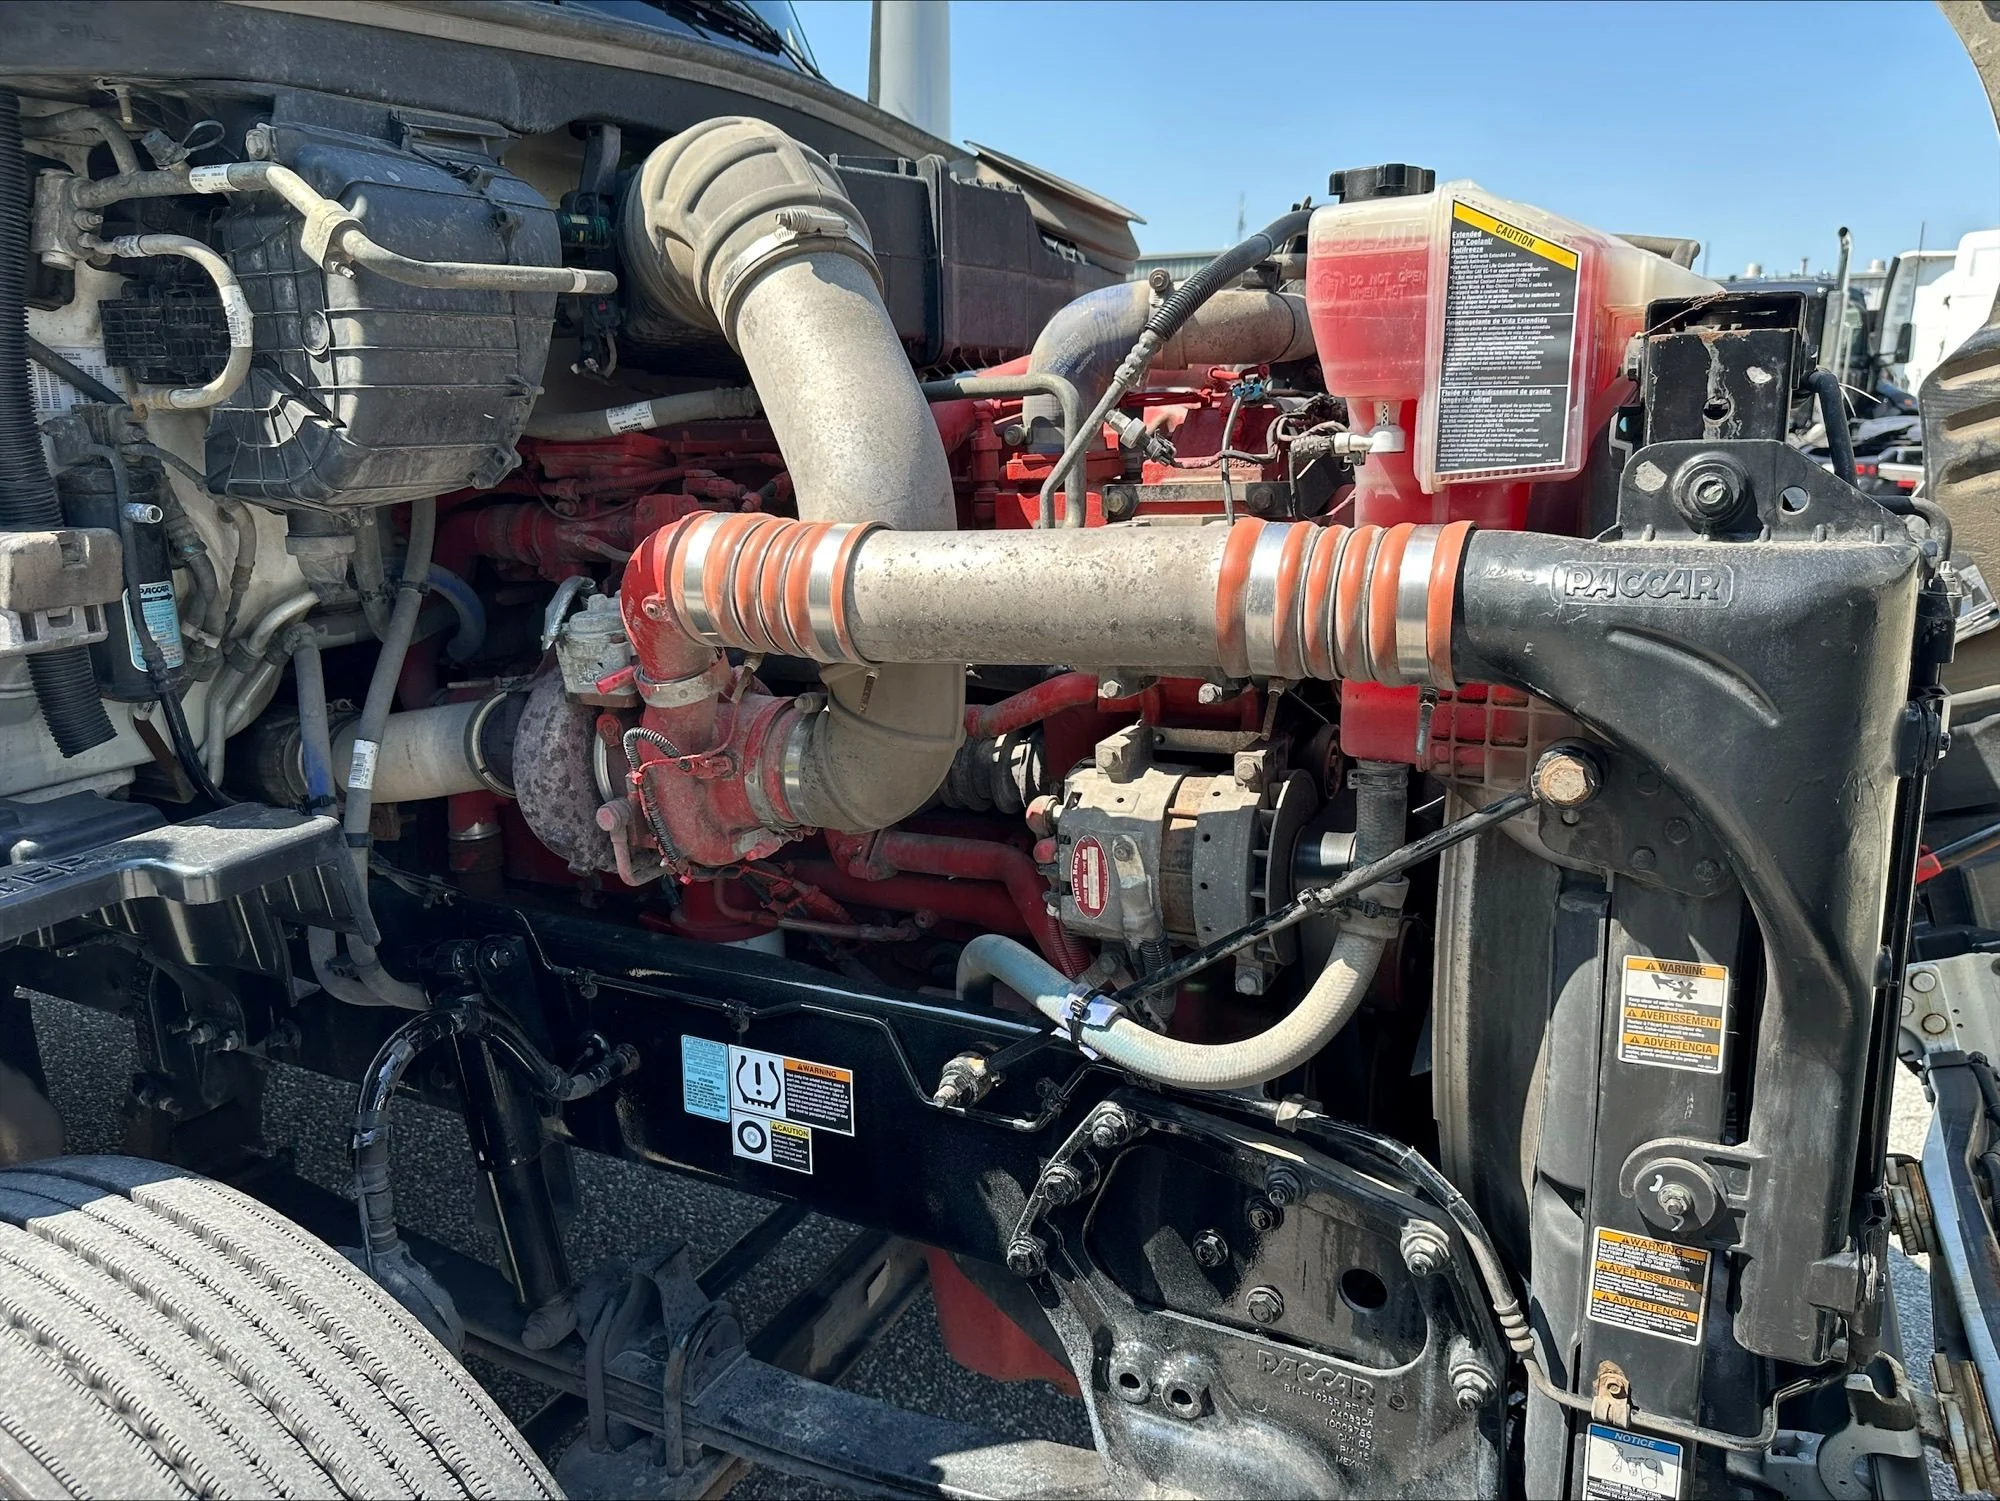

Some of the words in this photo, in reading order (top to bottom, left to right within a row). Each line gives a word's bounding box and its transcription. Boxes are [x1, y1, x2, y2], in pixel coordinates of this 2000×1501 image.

[1452, 230, 1482, 239] Extended
[1495, 223, 1536, 249] CAUTION
[1348, 274, 1364, 287] DO
[1369, 271, 1392, 286] NOT
[1398, 269, 1427, 285] OPEN
[1349, 285, 1378, 299] WHEN
[1384, 283, 1407, 298] HOT
[1565, 566, 1721, 600] PACCAR
[1658, 962, 1706, 976] WARNING
[1640, 1010, 1720, 1028] AVERTISSEMENT
[1643, 1037, 1713, 1053] ADVERTENCIA
[802, 1065, 837, 1078] WARNING
[778, 1125, 809, 1137] CAUTION
[1630, 1237, 1683, 1256] WARNING
[1609, 1264, 1698, 1291] AVERTISSEMENT
[1613, 1296, 1689, 1319] ADVERTENCIA
[1257, 1349, 1376, 1406] PACCAR
[1614, 1432, 1656, 1448] NOTICE
